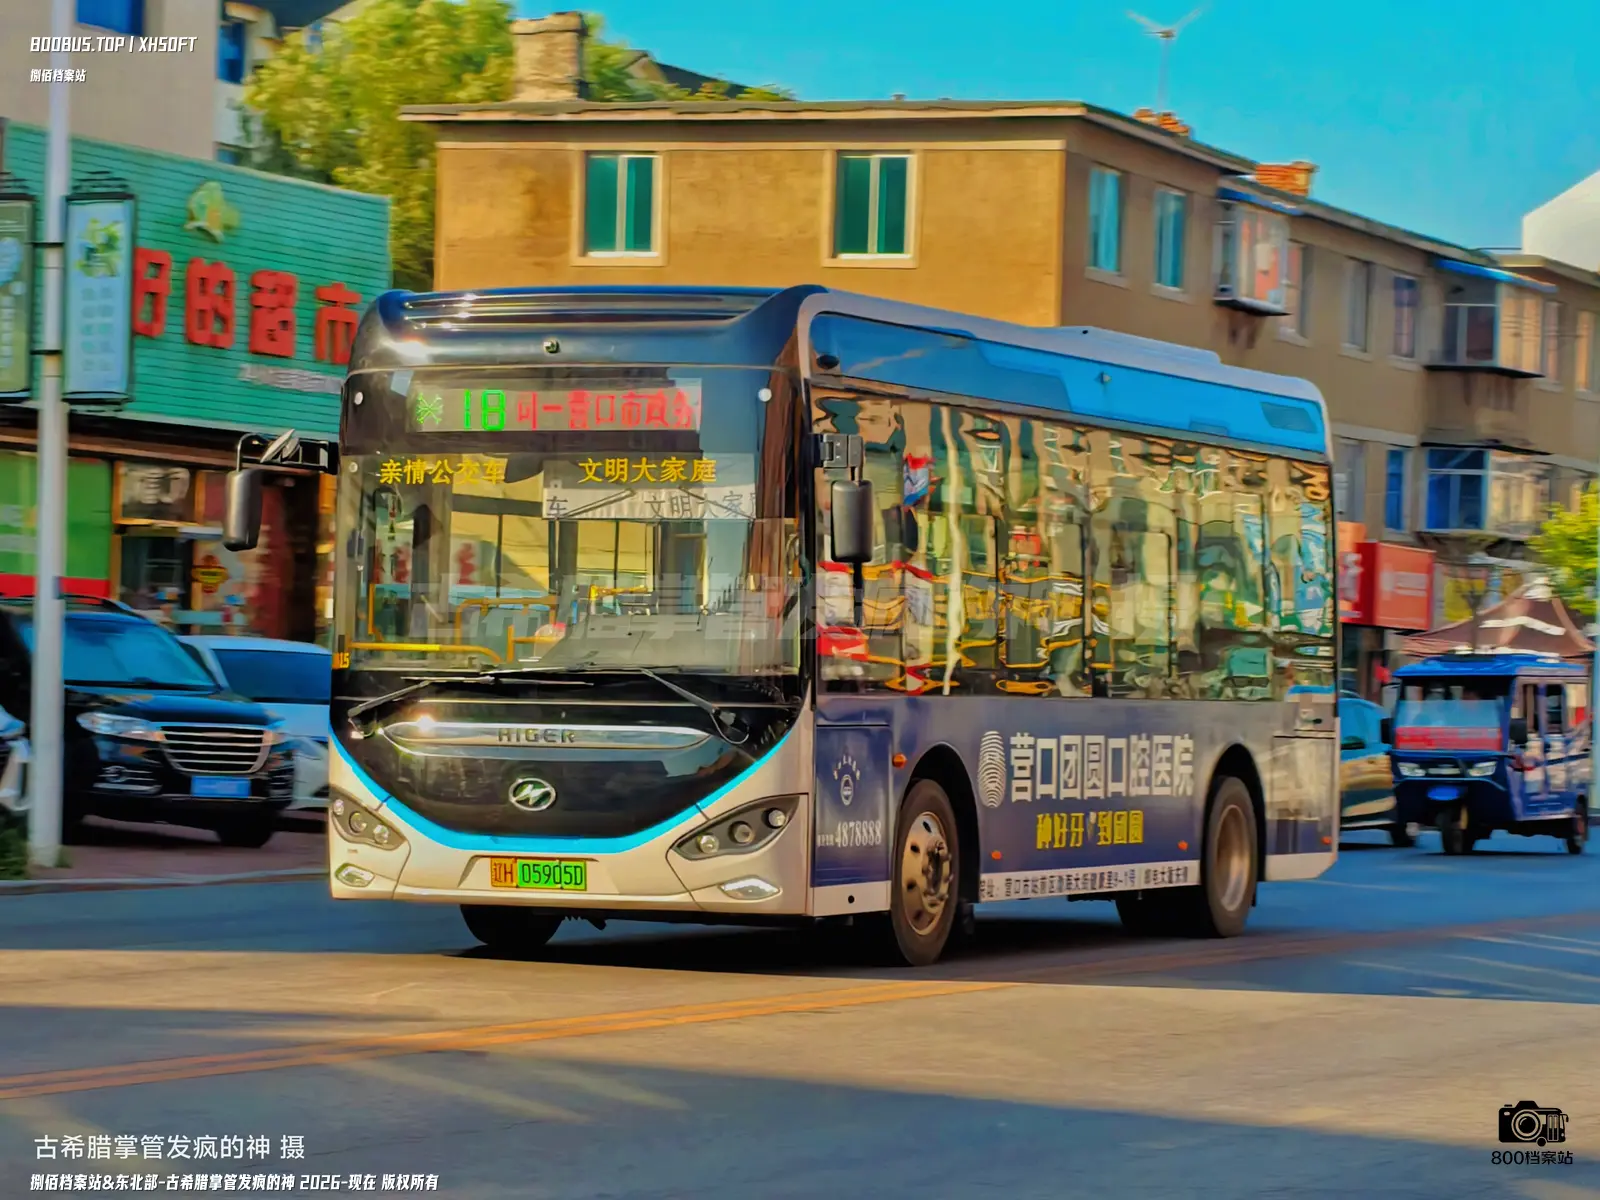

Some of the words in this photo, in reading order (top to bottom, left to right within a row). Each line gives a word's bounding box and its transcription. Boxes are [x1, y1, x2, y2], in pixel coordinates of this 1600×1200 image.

[463, 389, 505, 430] 18
[379, 459, 505, 485] 亲情公交车
[578, 456, 718, 484] 文明大家庭
[498, 728, 577, 743] HIGER
[1010, 732, 1195, 803] 营口团圆口腔医院
[835, 820, 882, 848] 4878888
